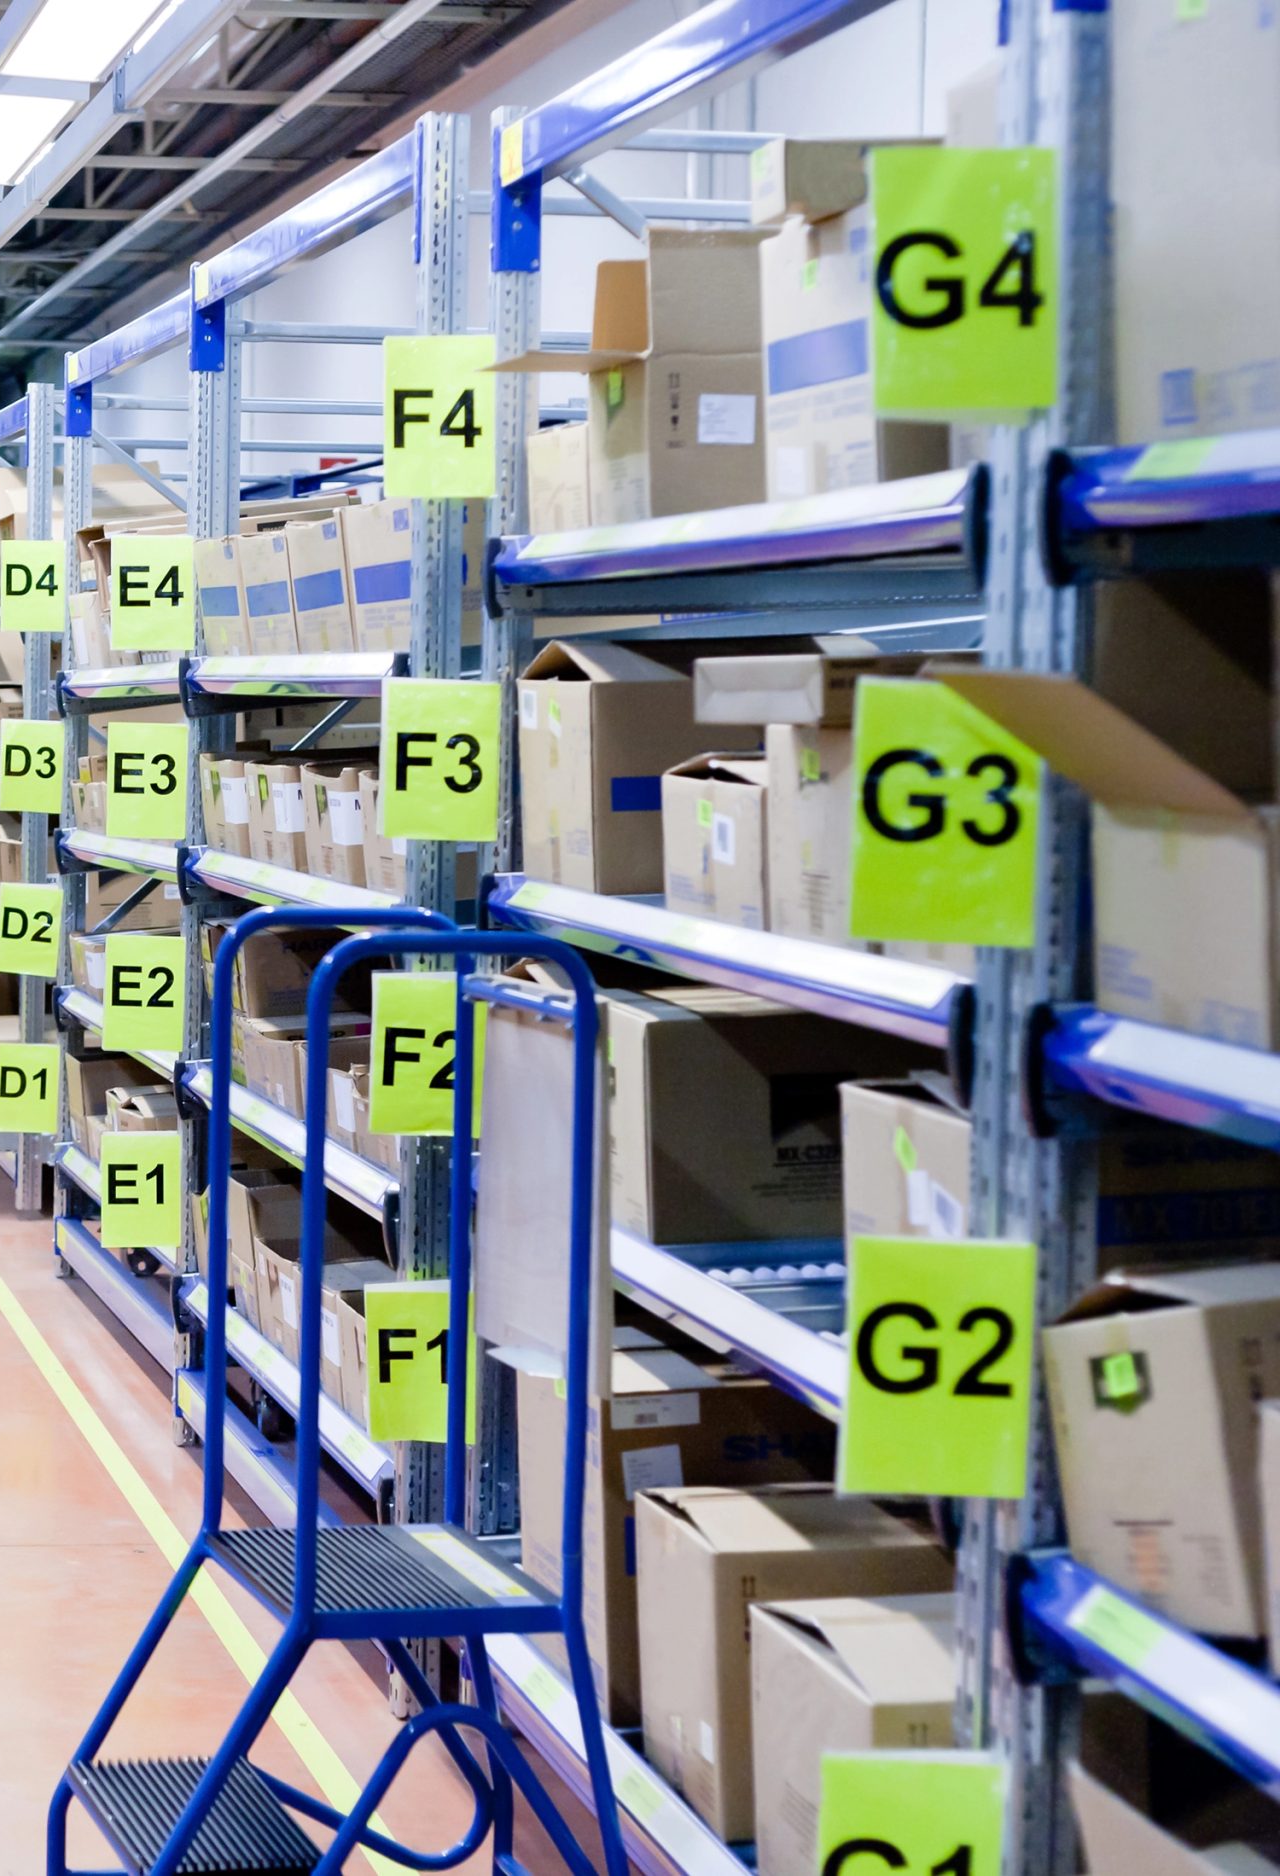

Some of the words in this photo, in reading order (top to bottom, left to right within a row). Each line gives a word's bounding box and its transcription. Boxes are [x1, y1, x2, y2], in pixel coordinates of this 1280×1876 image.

[875, 231, 1044, 330] G4
[394, 390, 481, 448] F4
[6, 564, 58, 596] D4
[120, 566, 183, 606] E4
[5, 745, 56, 778] D3
[114, 753, 176, 795] E3
[396, 733, 482, 793] F3
[862, 748, 1021, 847] G3
[2, 907, 53, 943] D2
[112, 966, 174, 1007] E2
[382, 1026, 455, 1090] F2
[0, 1066, 47, 1099] D1
[108, 1164, 164, 1204] E1
[856, 1302, 1014, 1397] G2
